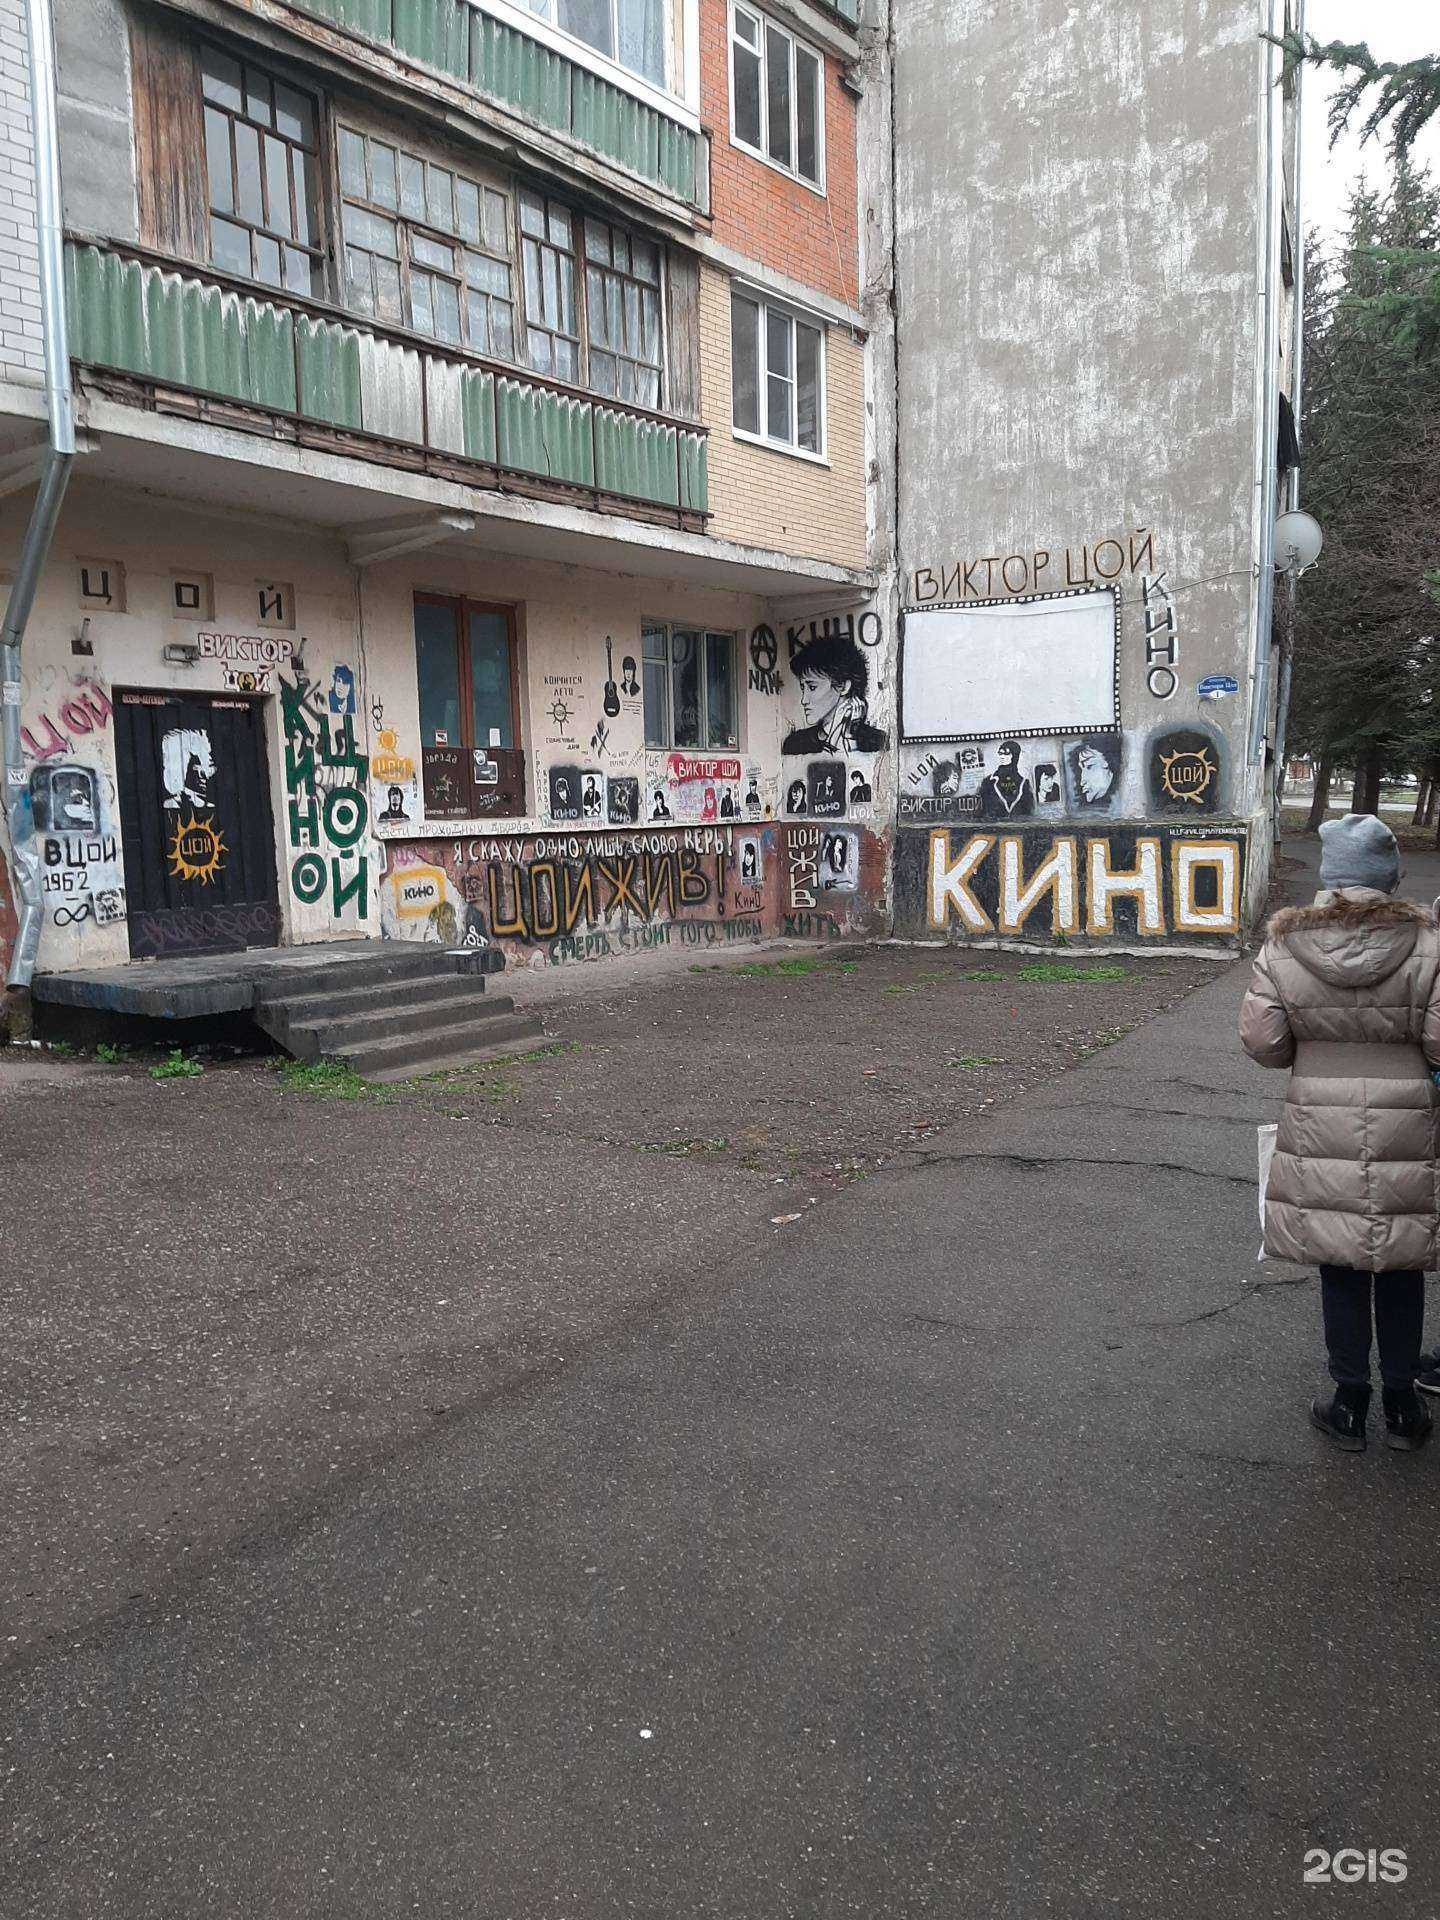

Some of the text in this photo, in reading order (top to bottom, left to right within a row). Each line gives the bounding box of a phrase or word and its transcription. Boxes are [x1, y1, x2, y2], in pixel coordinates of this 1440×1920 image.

[915, 528, 1155, 602] ВИКТОР ЦОЙ
[198, 633, 293, 662] ВИКТОР
[787, 611, 882, 656] КИНО
[1142, 572, 1180, 700] КИНО
[223, 661, 275, 693] ЦОЙ
[544, 676, 582, 685] КОНЧИТСЯ
[553, 688, 574, 697] ЛЕТО
[678, 760, 718, 778] ВИКТОР
[721, 759, 738, 777] ЦОЙ
[907, 754, 939, 786] ЦОЙ
[1171, 763, 1204, 785] ЦОЙ
[278, 672, 327, 904] КИНО
[321, 713, 370, 919] ЦОЙ
[553, 808, 578, 819] КИНО
[609, 811, 632, 823] КИНО
[814, 802, 840, 813] КИНО
[900, 794, 982, 813] ВИКТОР ЦОЙ
[453, 838, 464, 863] Я
[469, 837, 525, 865] СКАЖУ
[535, 837, 580, 860] ОДНО
[586, 835, 625, 858] ЛИШЬ
[631, 834, 677, 855] СЛОВО
[787, 826, 819, 850] ЦОЙ
[43, 871, 90, 892] 1962
[404, 885, 435, 901] КИНО
[788, 850, 818, 909] ЖИВ
[926, 828, 1240, 936] КИНО
[550, 930, 610, 967] СМЕРТЬ
[619, 921, 672, 949] СТОИТ
